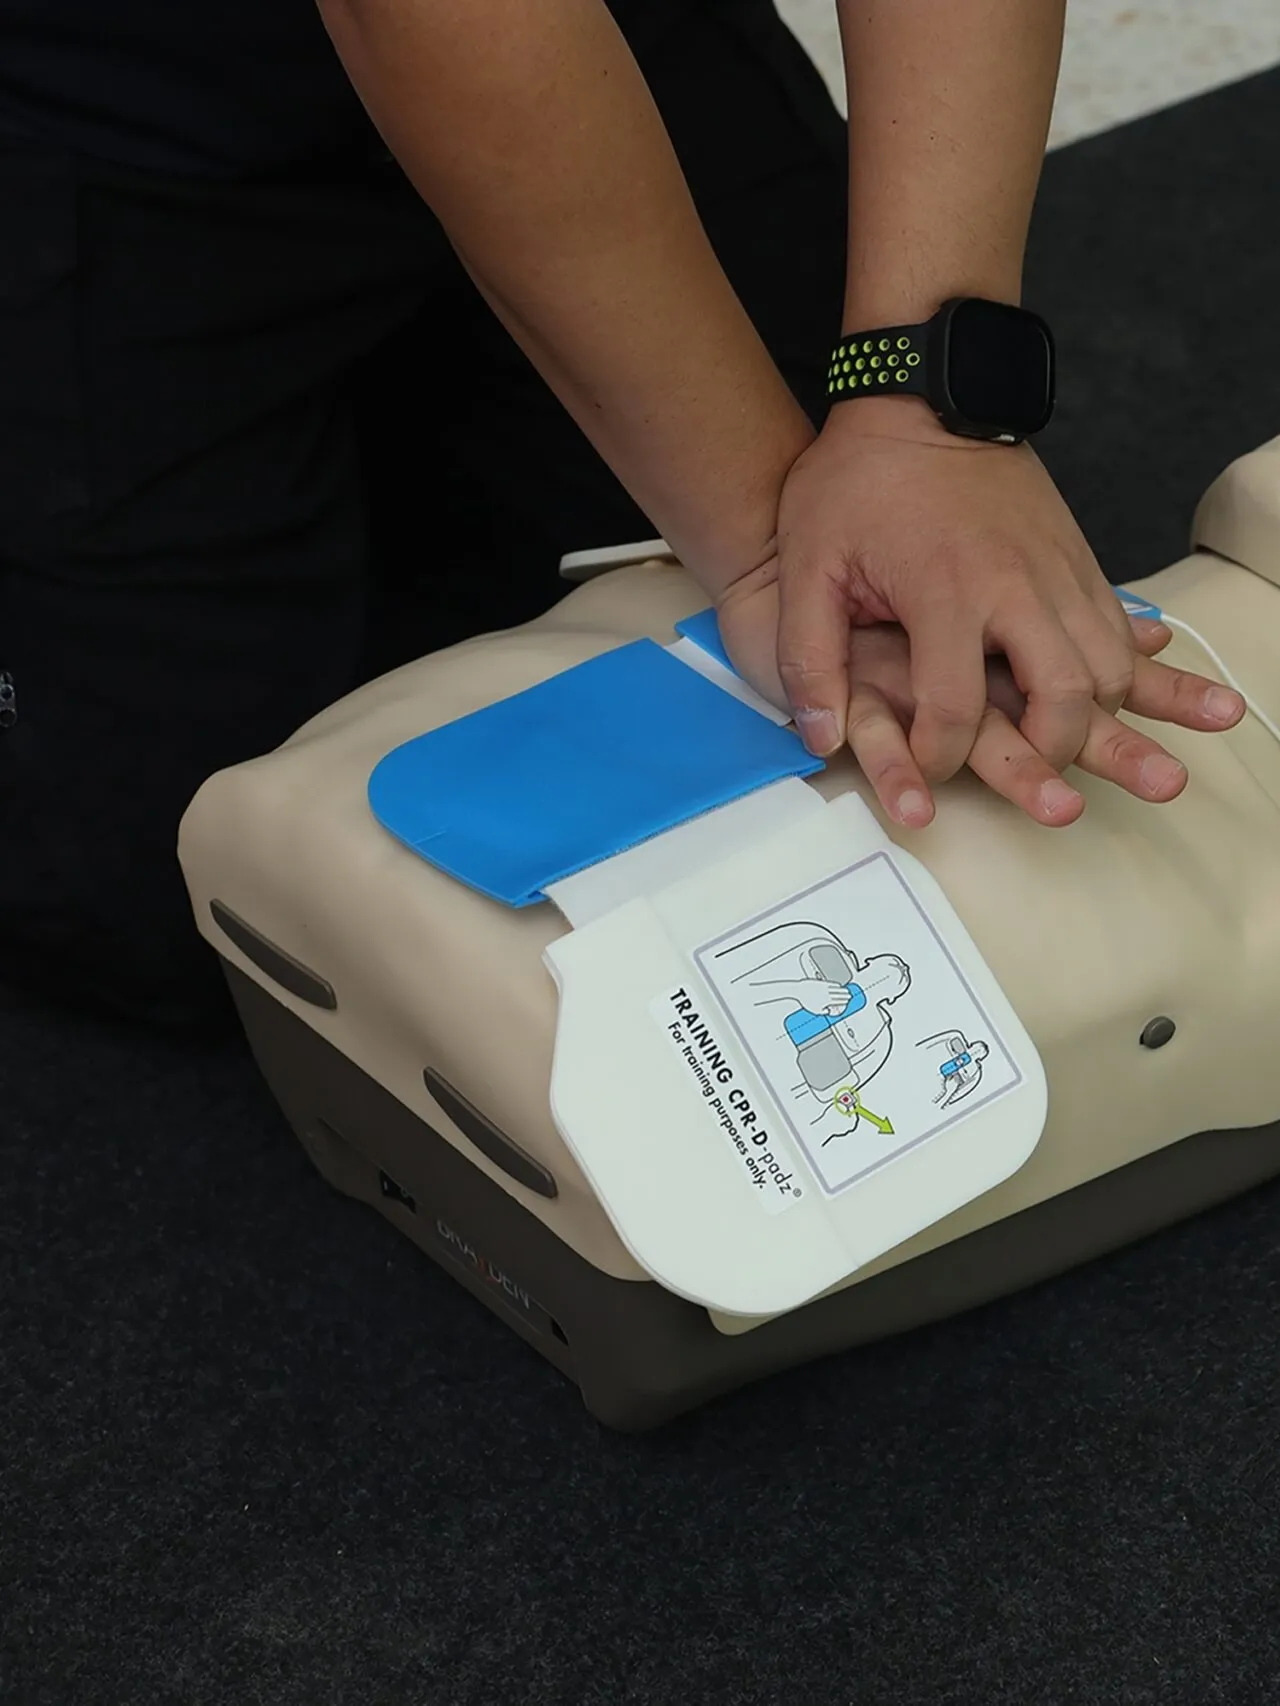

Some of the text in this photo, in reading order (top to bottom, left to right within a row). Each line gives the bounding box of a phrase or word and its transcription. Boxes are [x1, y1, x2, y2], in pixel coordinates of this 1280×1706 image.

[669, 987, 734, 1084] TRAINING
[667, 1020, 768, 1189] For training purposes only.
